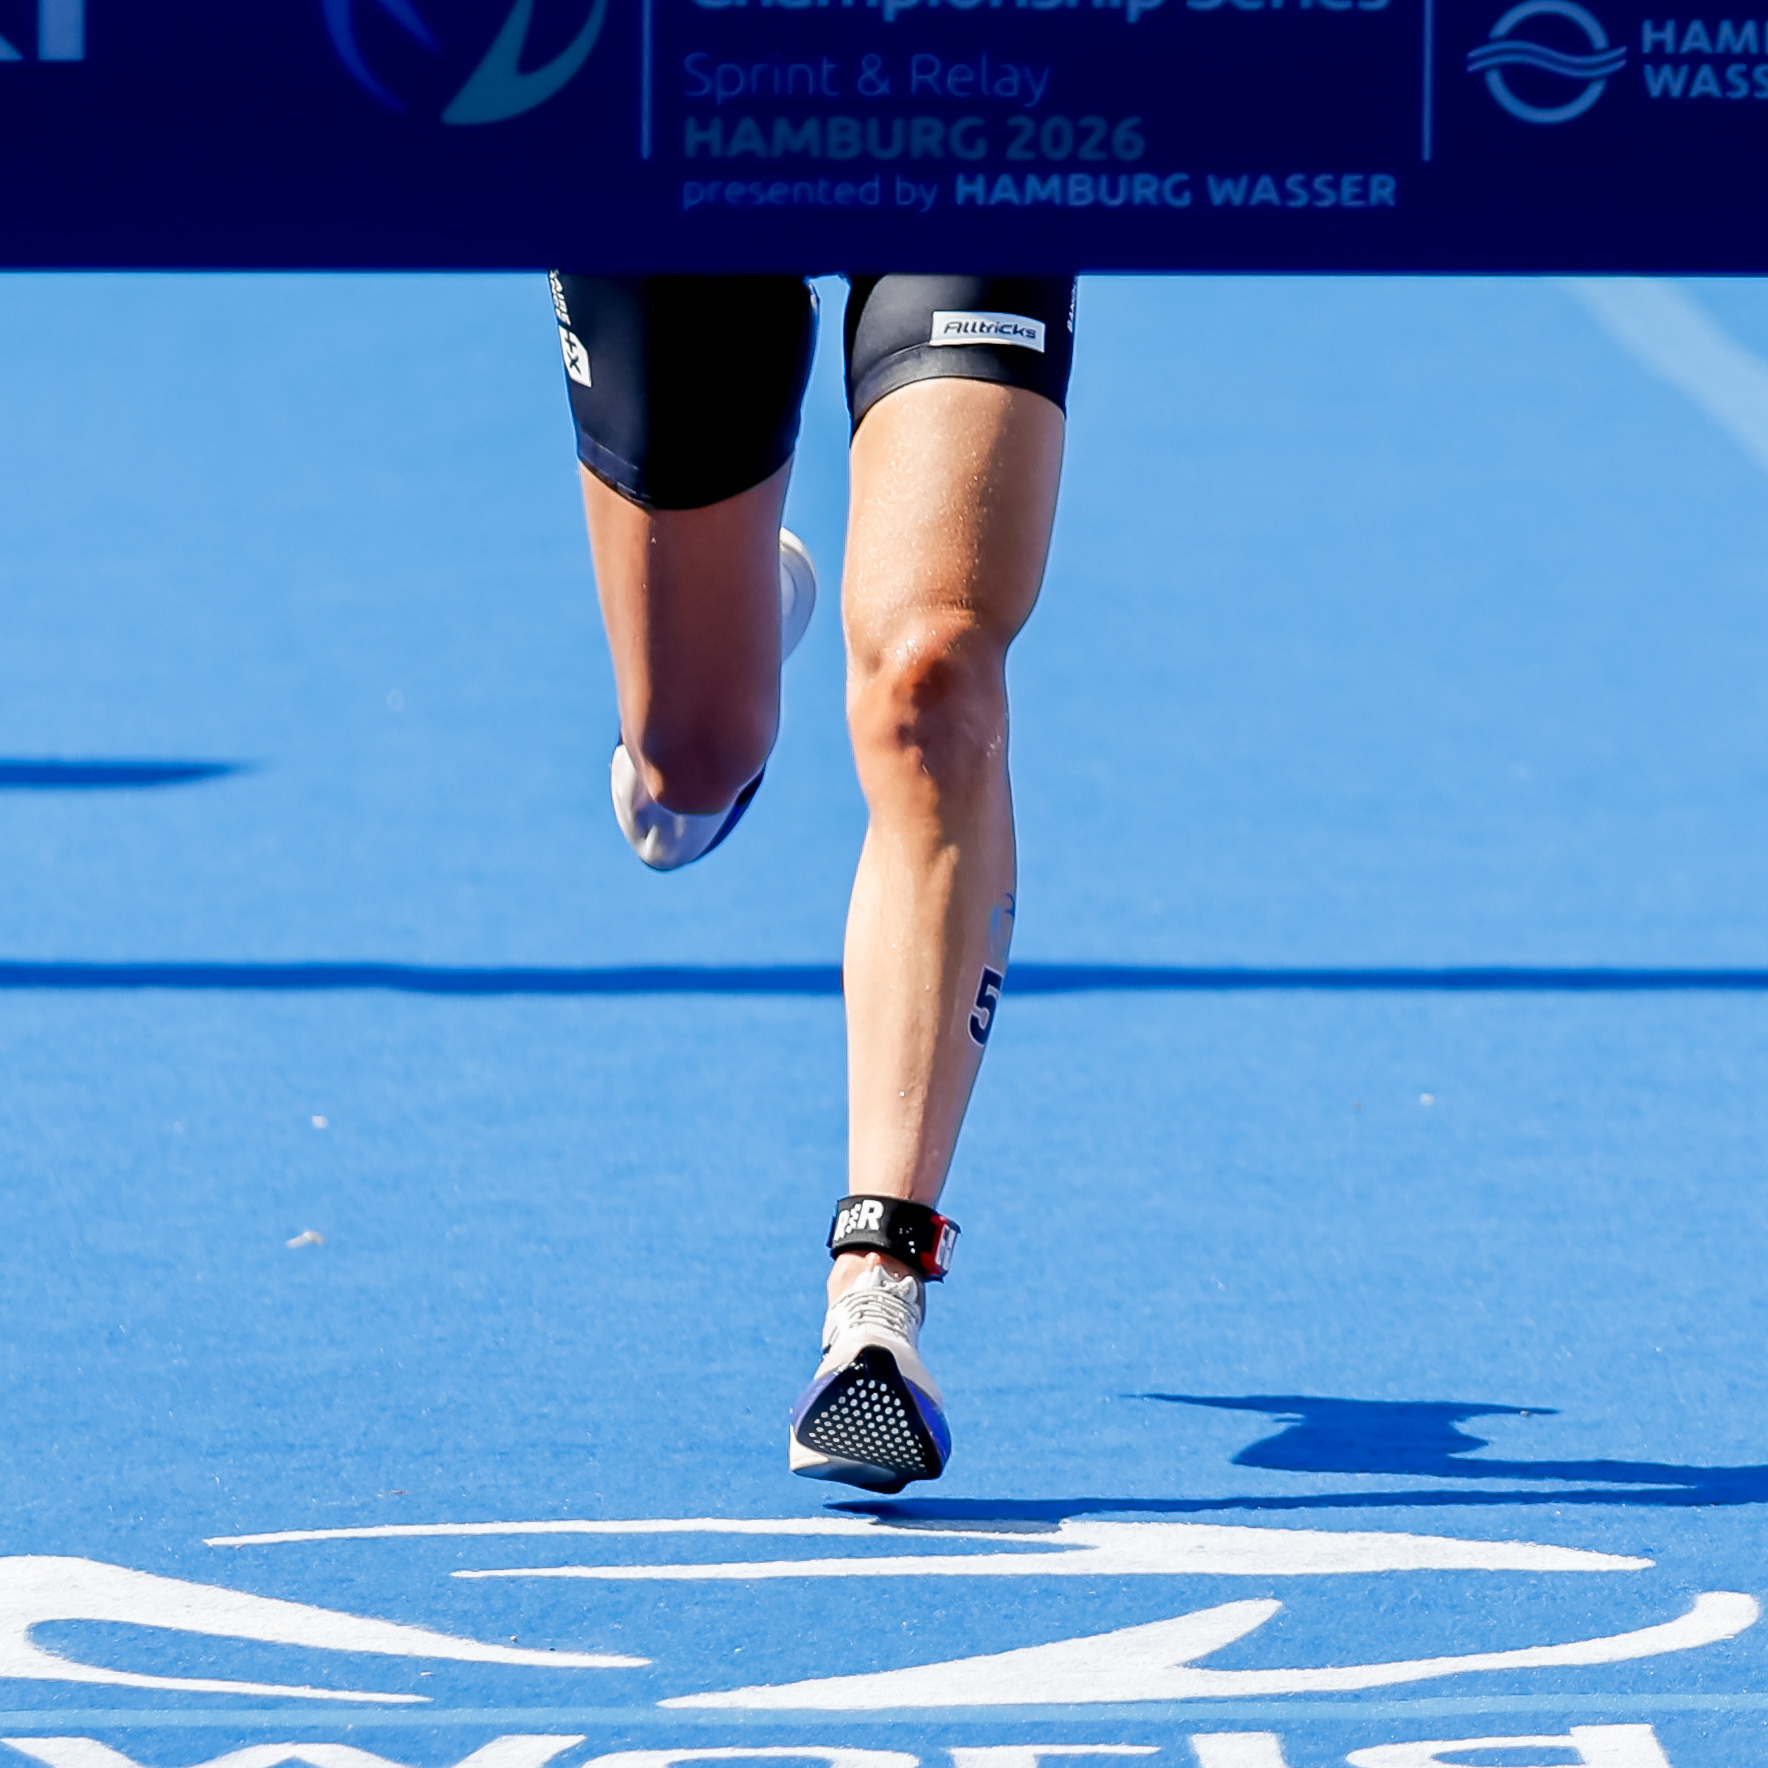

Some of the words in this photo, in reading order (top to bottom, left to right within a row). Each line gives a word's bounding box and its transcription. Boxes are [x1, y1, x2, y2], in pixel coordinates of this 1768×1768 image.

[683, 51, 839, 106] Sprint
[856, 52, 891, 97] &
[910, 52, 1050, 108] Relay
[683, 115, 987, 160] HAMBURG
[1005, 114, 1146, 162] 2026
[682, 173, 882, 211] presented
[894, 174, 938, 213] by
[955, 172, 1192, 207] HAMBURG
[1207, 173, 1396, 208] WASSER
[944, 320, 1037, 340] Alltricks
[967, 963, 1005, 1048] 5
